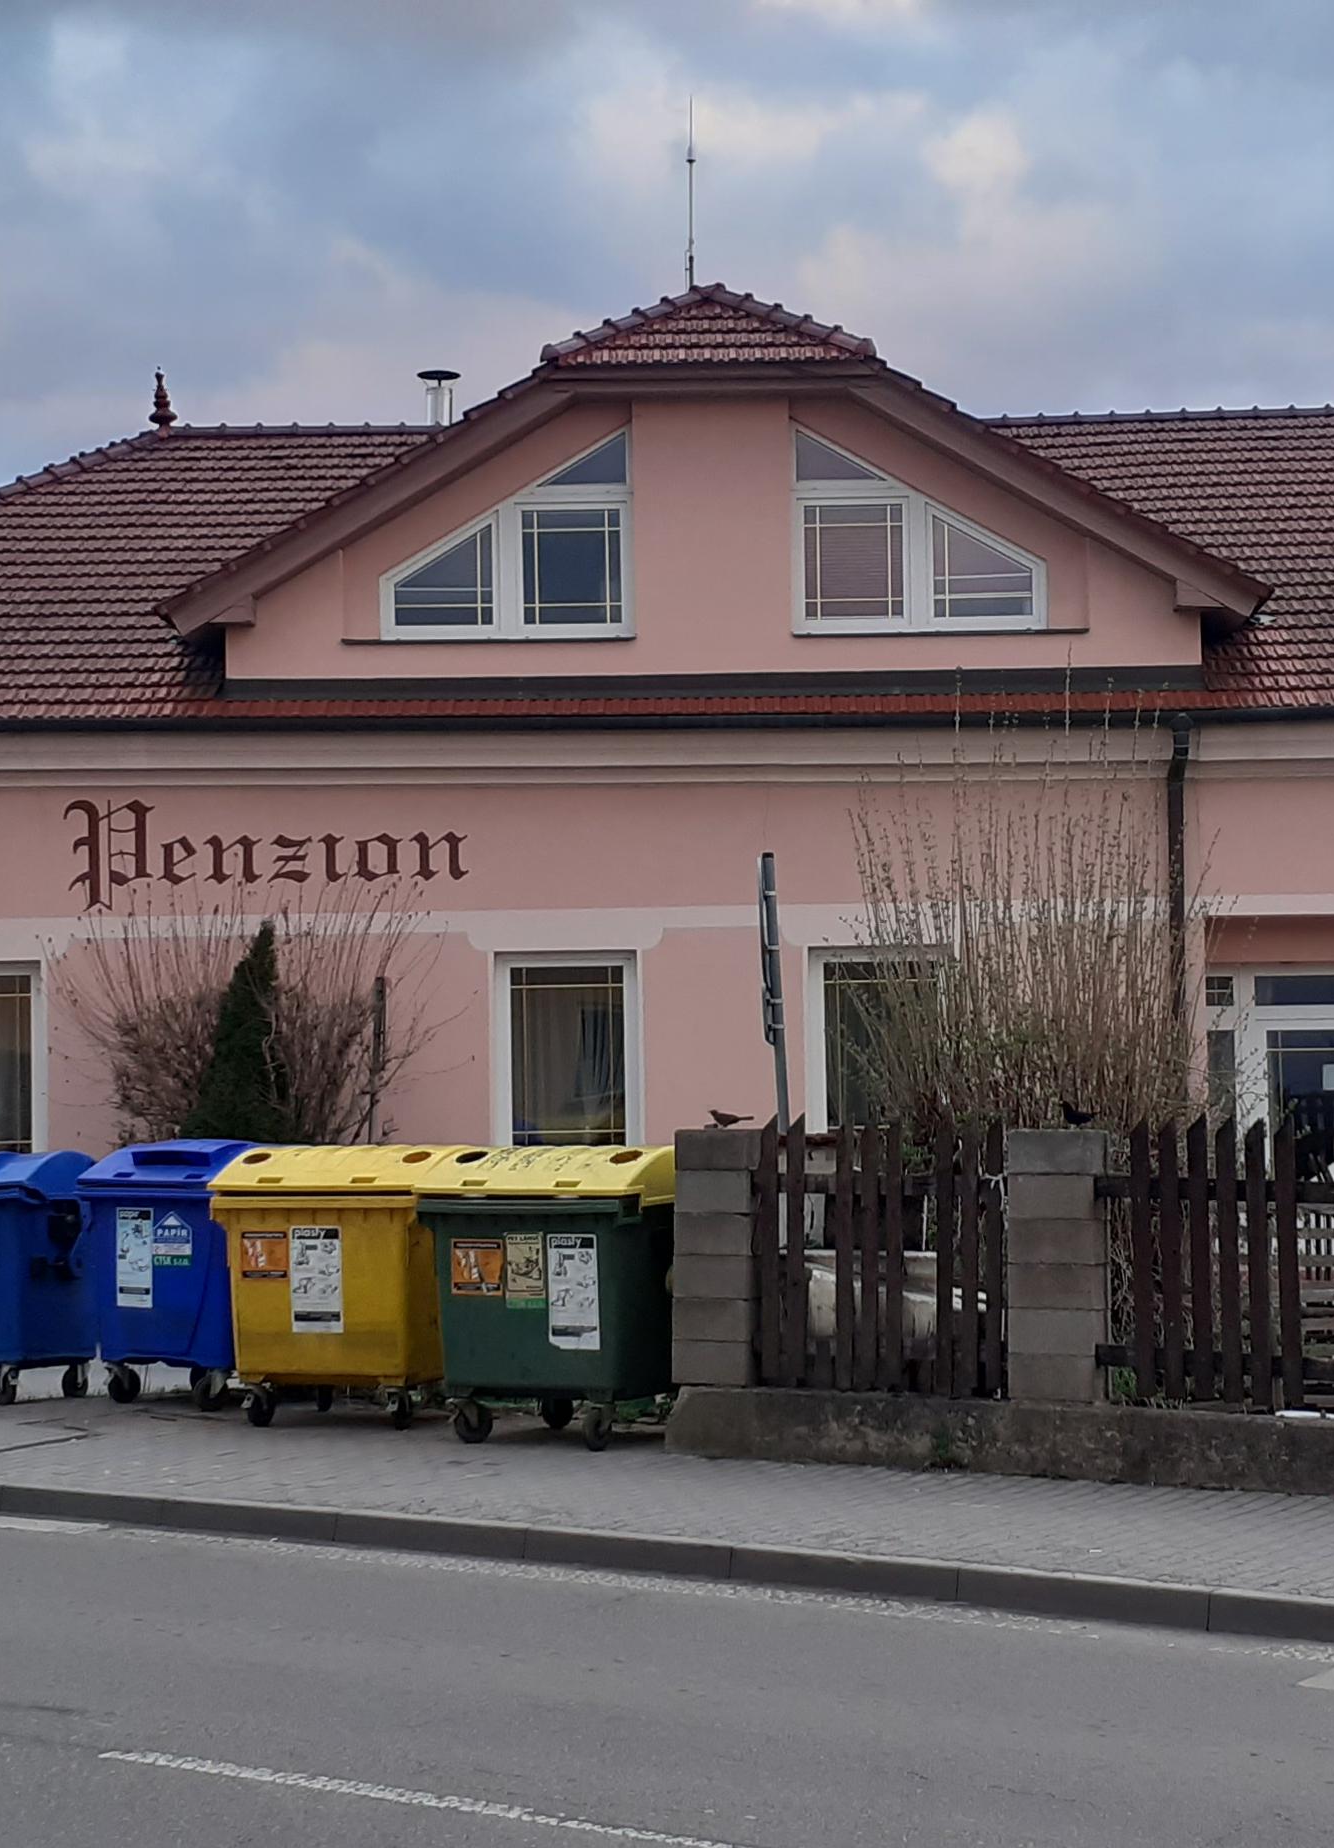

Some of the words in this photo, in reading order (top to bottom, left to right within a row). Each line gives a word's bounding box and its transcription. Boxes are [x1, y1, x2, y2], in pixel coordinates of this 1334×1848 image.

[64, 799, 469, 911] Penzion
[294, 1227, 327, 1239] plasty
[551, 1236, 582, 1248] plasty
